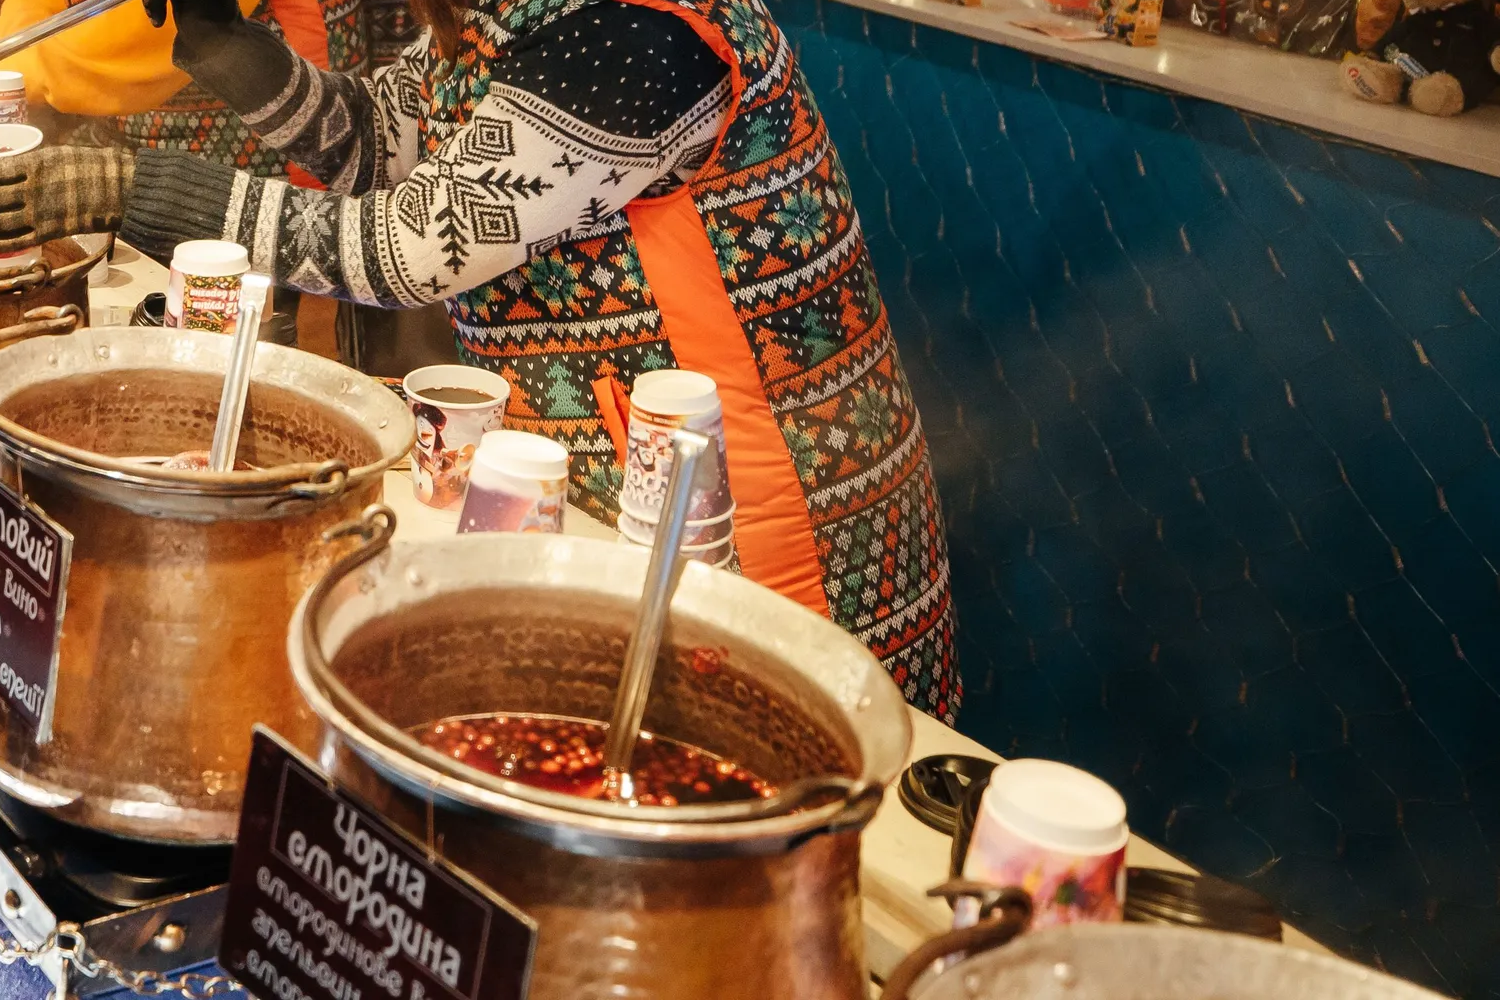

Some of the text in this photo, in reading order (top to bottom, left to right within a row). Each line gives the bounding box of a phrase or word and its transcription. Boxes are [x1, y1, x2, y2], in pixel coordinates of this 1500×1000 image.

[192, 301, 238, 314] 12 грудня
[4, 567, 38, 621] вино
[0, 661, 45, 718] спеції
[333, 803, 427, 910] Чорна
[256, 866, 404, 998] смородинове
[287, 831, 462, 990] смородина
